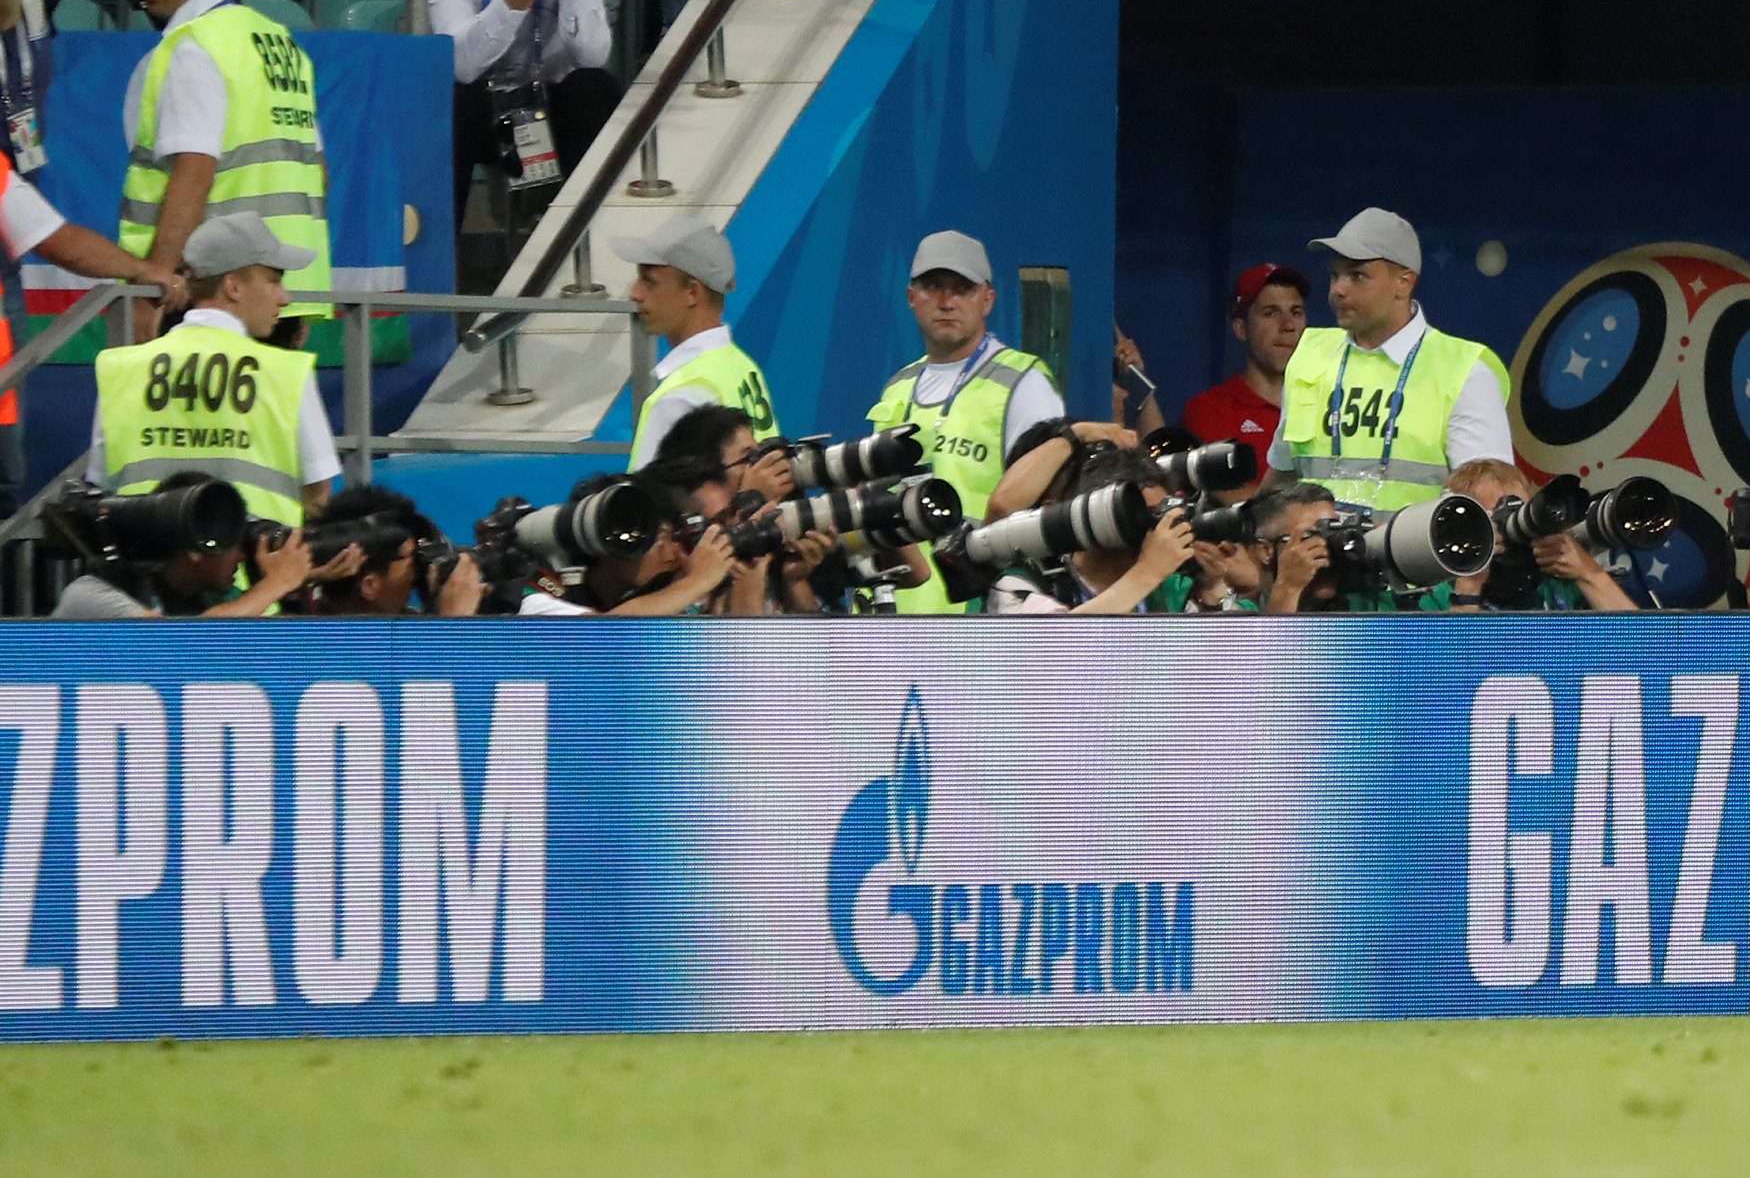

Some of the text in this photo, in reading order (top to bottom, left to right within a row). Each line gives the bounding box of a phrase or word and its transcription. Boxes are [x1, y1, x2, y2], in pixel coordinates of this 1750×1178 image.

[144, 352, 261, 415] 8406
[140, 427, 251, 450] STEWARD
[1322, 386, 1405, 439] 8542
[932, 434, 988, 463] 2150
[940, 881, 1195, 995] GAZPROM
